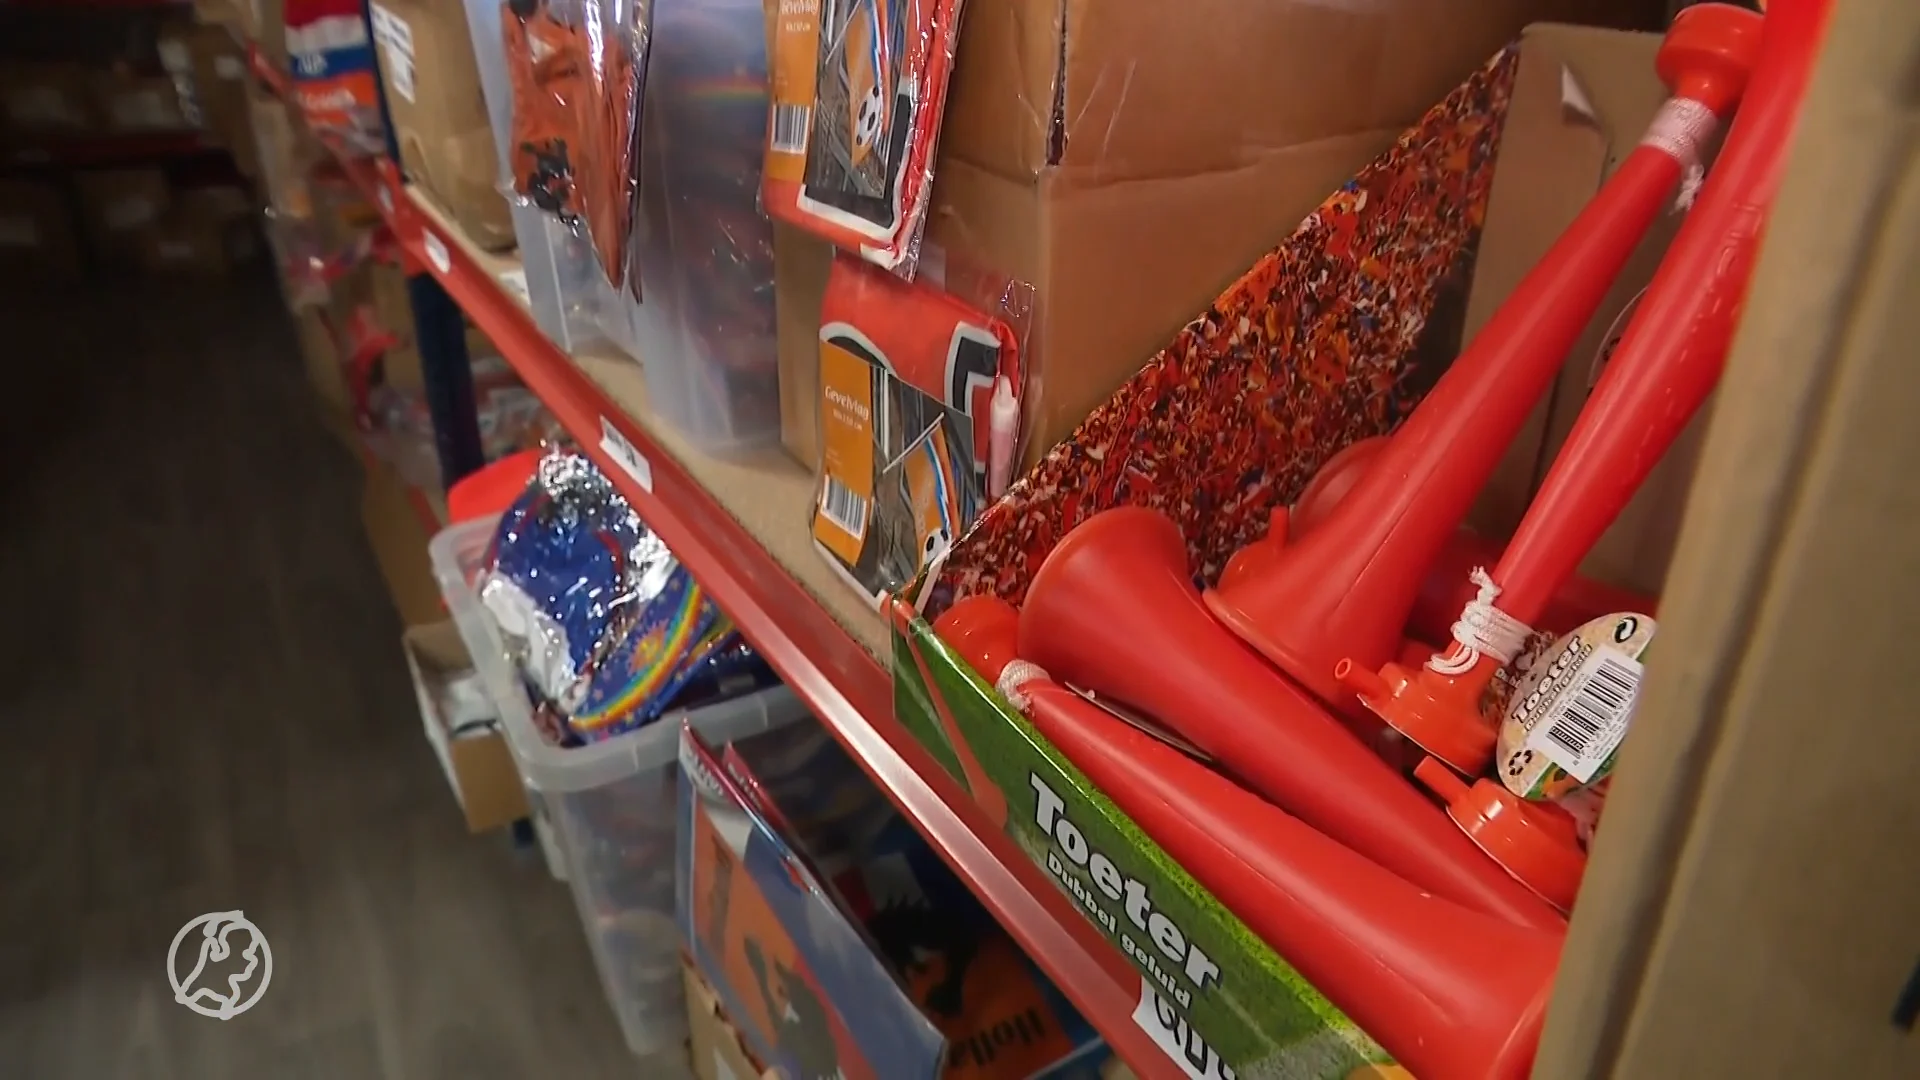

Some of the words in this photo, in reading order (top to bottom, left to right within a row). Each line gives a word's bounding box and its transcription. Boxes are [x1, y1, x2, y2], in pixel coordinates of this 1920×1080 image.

[1511, 635, 1581, 724] Toeter
[1029, 771, 1221, 990] Toeter
[1047, 850, 1117, 934] Dubbel
[1121, 934, 1192, 1010] geluid
